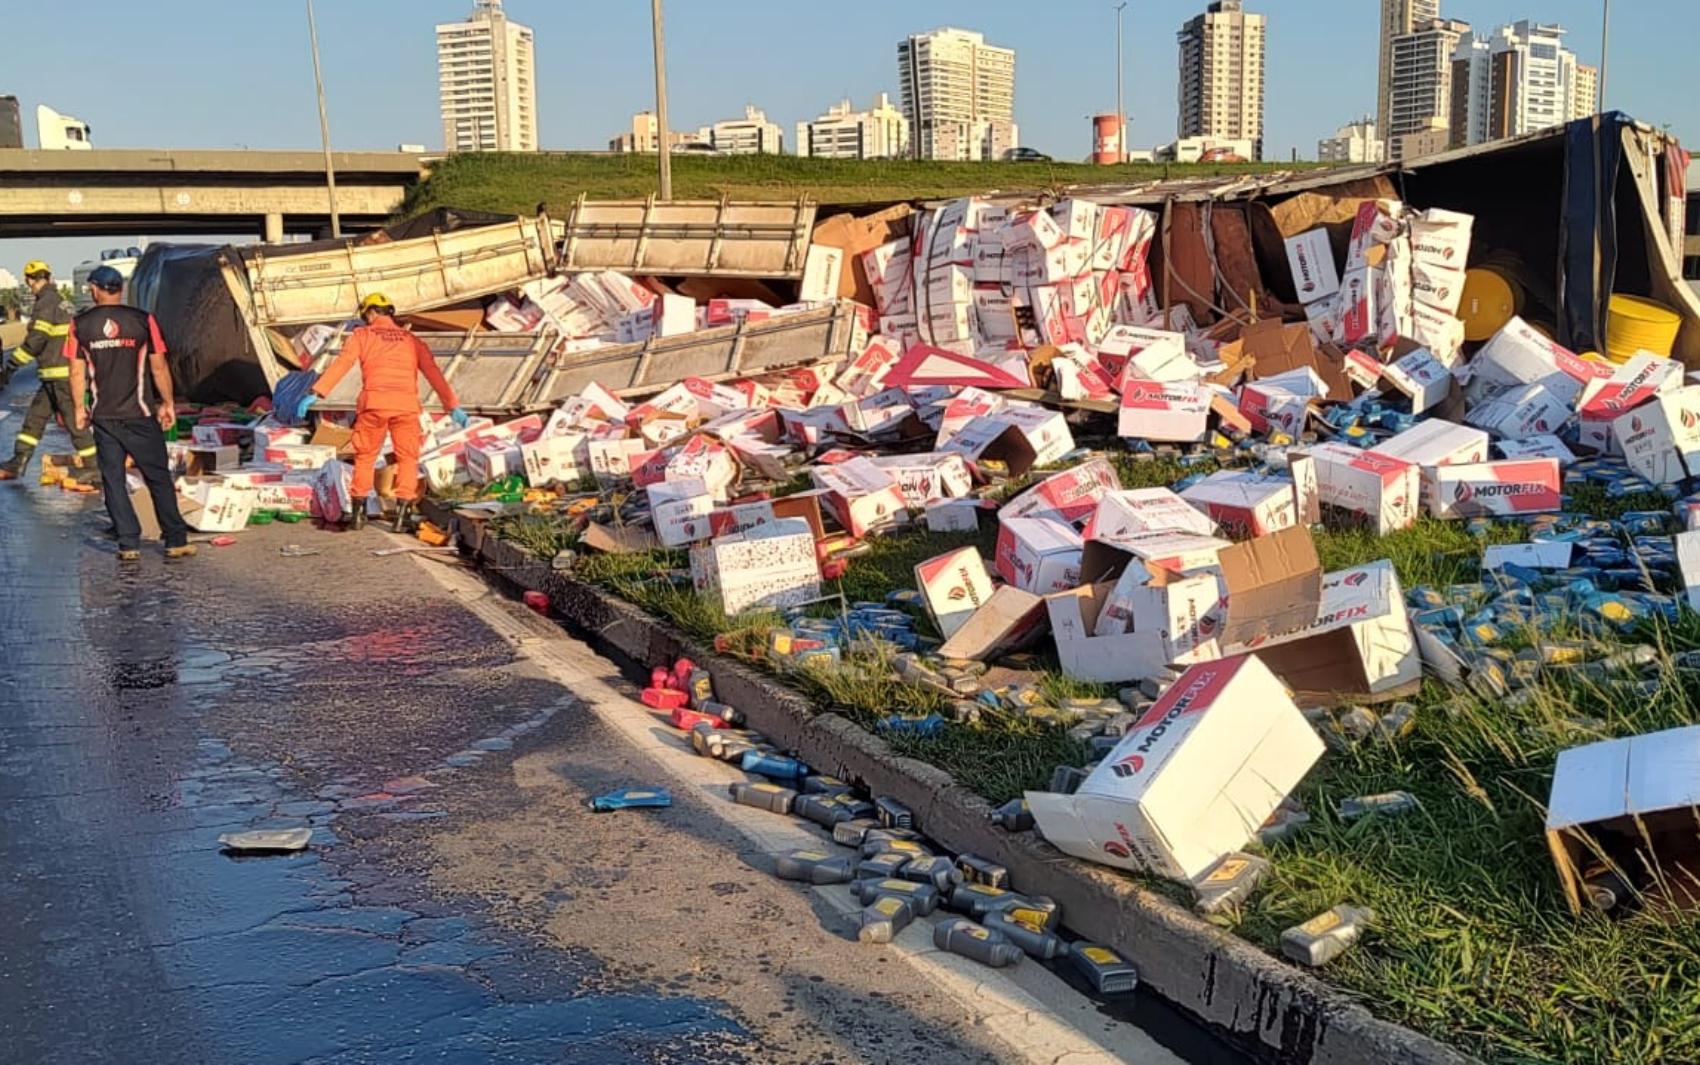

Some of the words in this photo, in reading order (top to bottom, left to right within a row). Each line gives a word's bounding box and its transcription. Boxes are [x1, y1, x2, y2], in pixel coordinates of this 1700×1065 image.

[1297, 243, 1310, 281] MOTORFIX
[1148, 393, 1199, 403] MOTORFIX
[1620, 361, 1661, 399] MOTORFIX
[1475, 482, 1546, 498] MOTORFIX
[1136, 671, 1217, 753] MOTORFIX
